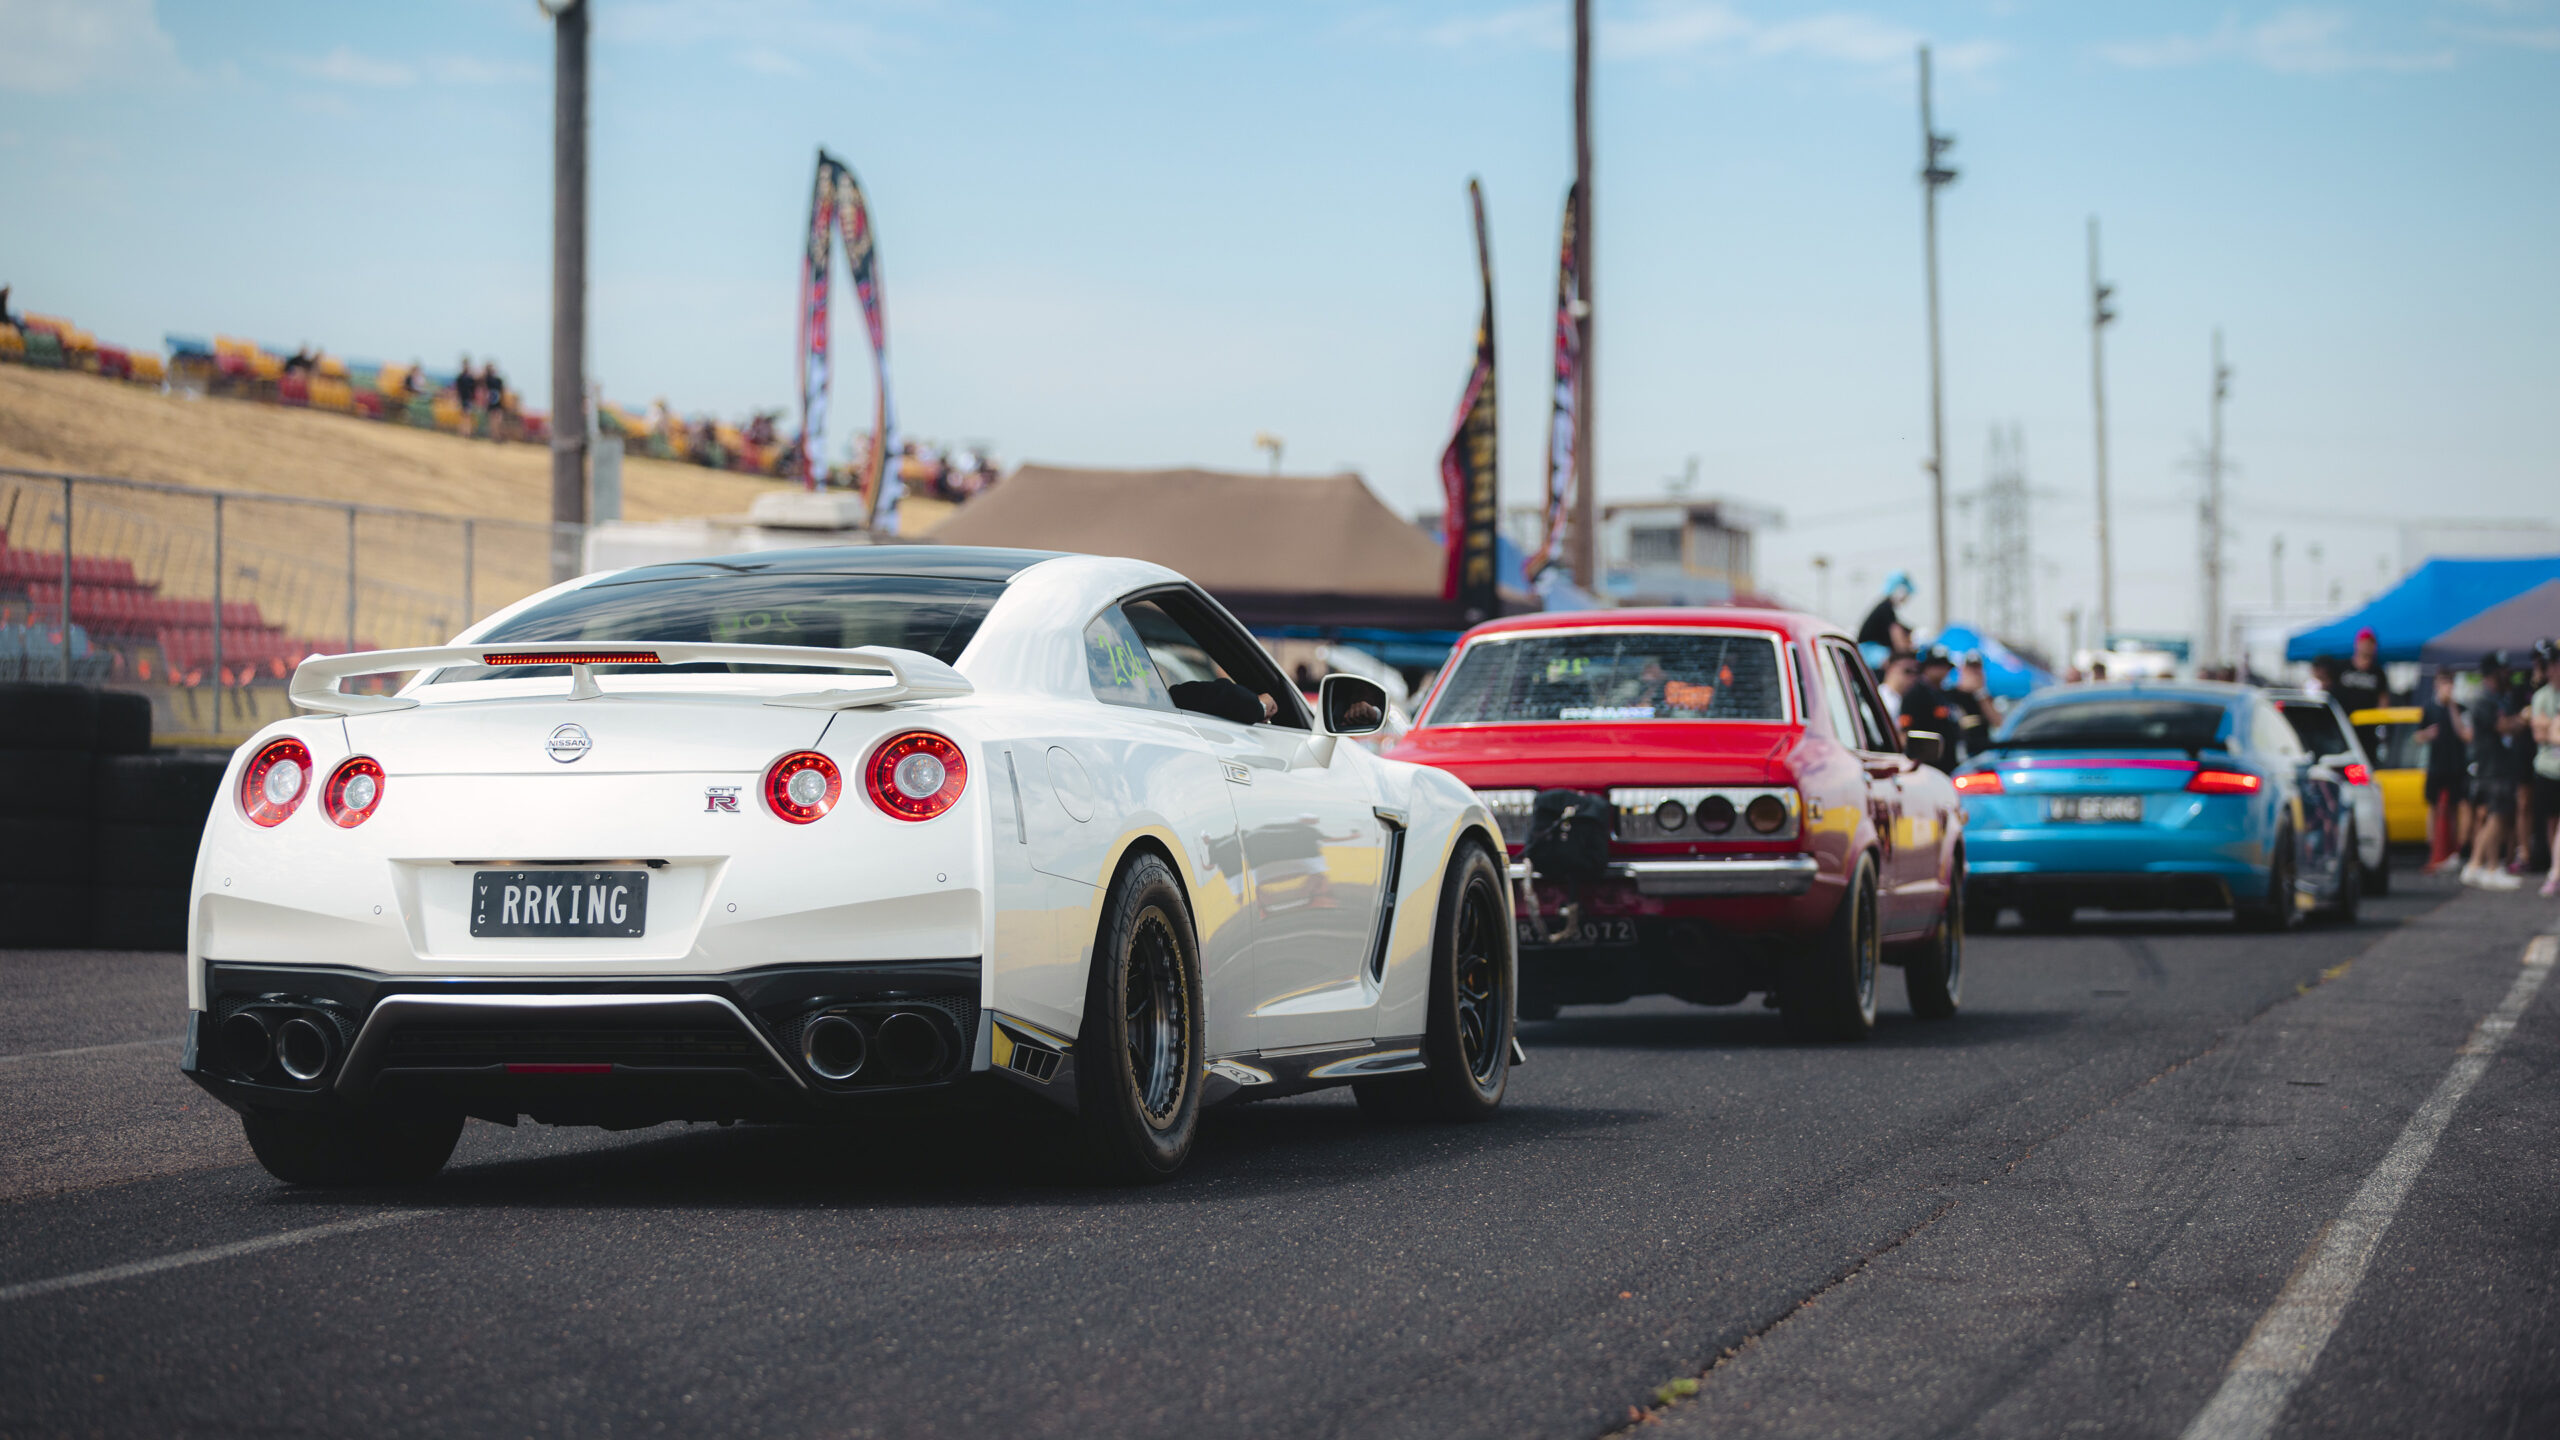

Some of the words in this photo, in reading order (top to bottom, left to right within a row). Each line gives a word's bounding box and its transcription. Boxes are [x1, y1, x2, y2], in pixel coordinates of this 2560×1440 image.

[1098, 635, 1150, 688] 204
[549, 739, 586, 747] NISSAN
[477, 885, 489, 925] VIC
[502, 885, 628, 924] RRKING
